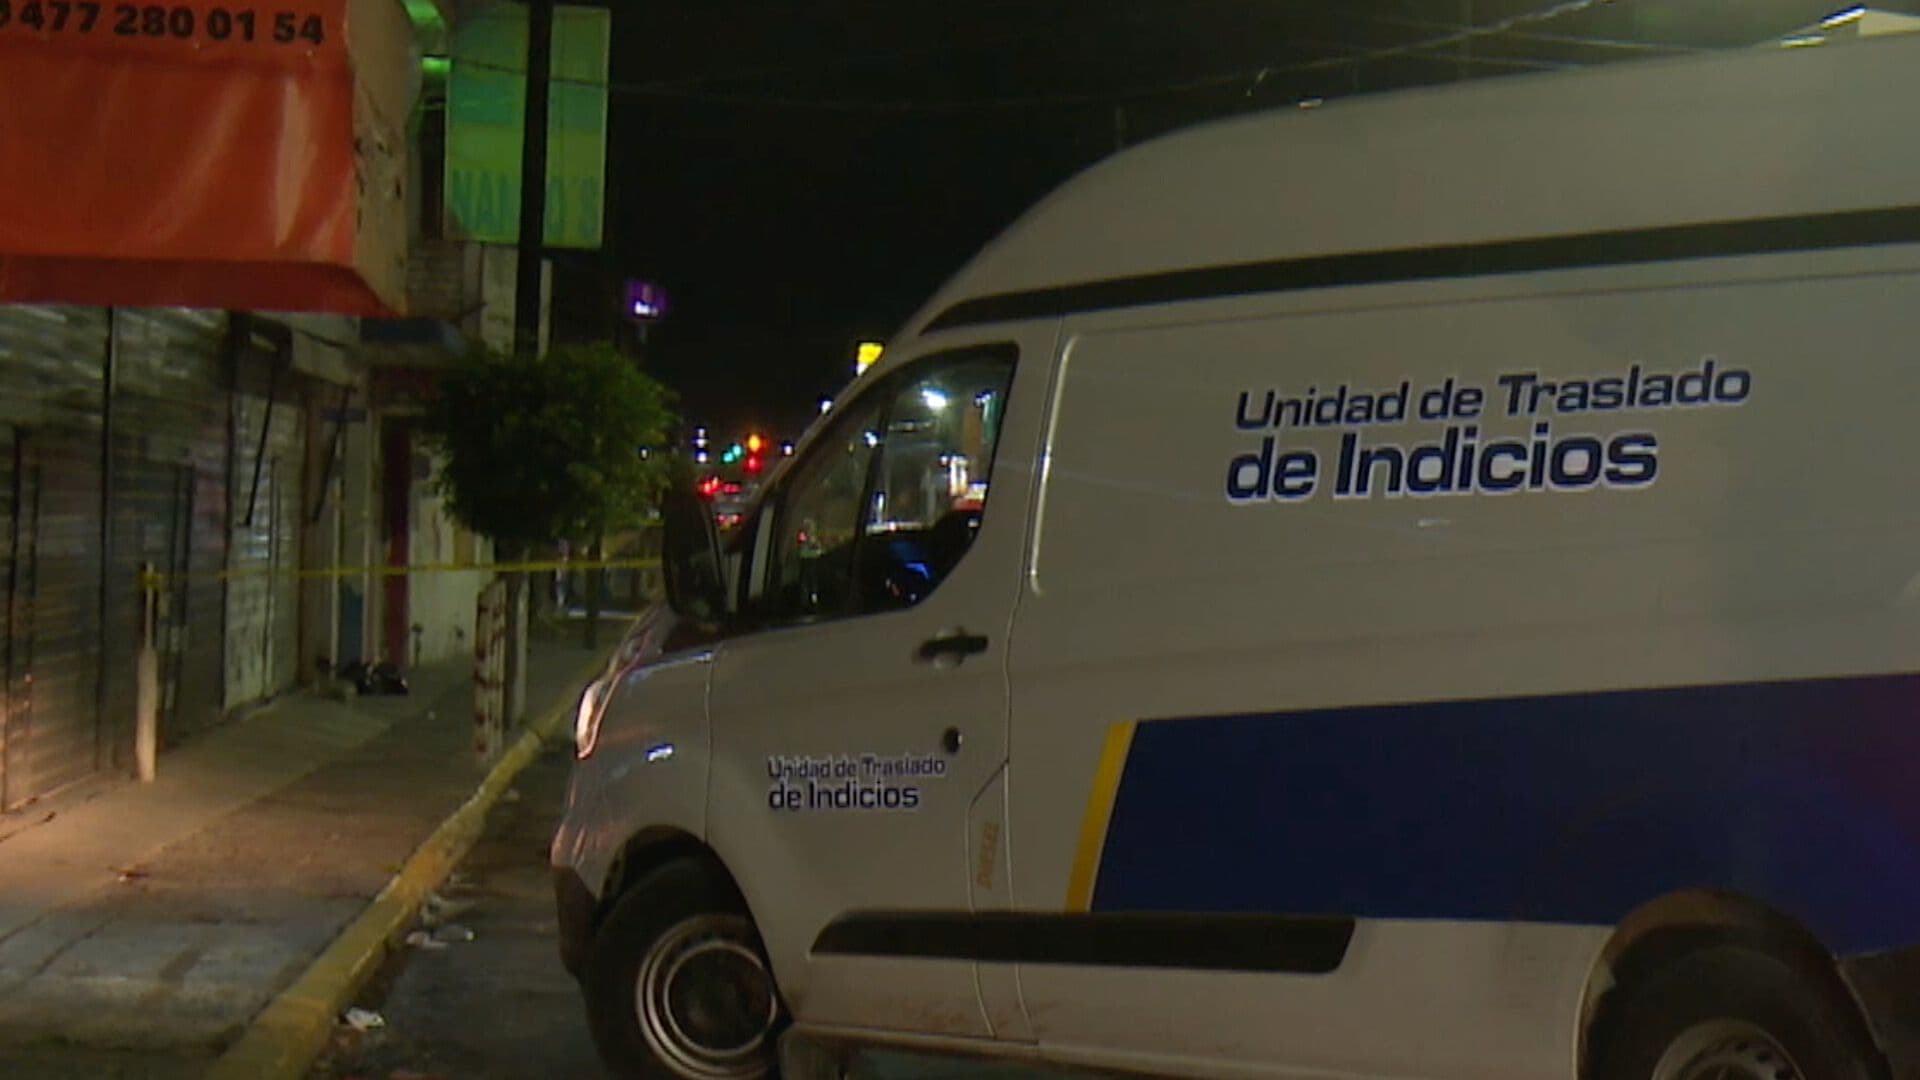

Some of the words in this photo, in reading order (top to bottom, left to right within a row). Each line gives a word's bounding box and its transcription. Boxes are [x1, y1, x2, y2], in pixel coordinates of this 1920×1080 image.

[19, 0, 99, 33] 477
[114, 4, 194, 38] 280
[207, 7, 255, 41] 01
[273, 11, 324, 44] 54
[1235, 381, 1409, 430] Unidad
[1418, 377, 1484, 421] de
[1498, 360, 1753, 416] Traslado
[1226, 434, 1318, 500] de
[1334, 421, 1660, 498] Indicios
[767, 755, 831, 778] Unidad
[834, 756, 857, 777] de
[861, 753, 946, 777] Traslado
[767, 781, 801, 810] de
[808, 779, 920, 810] Indicios
